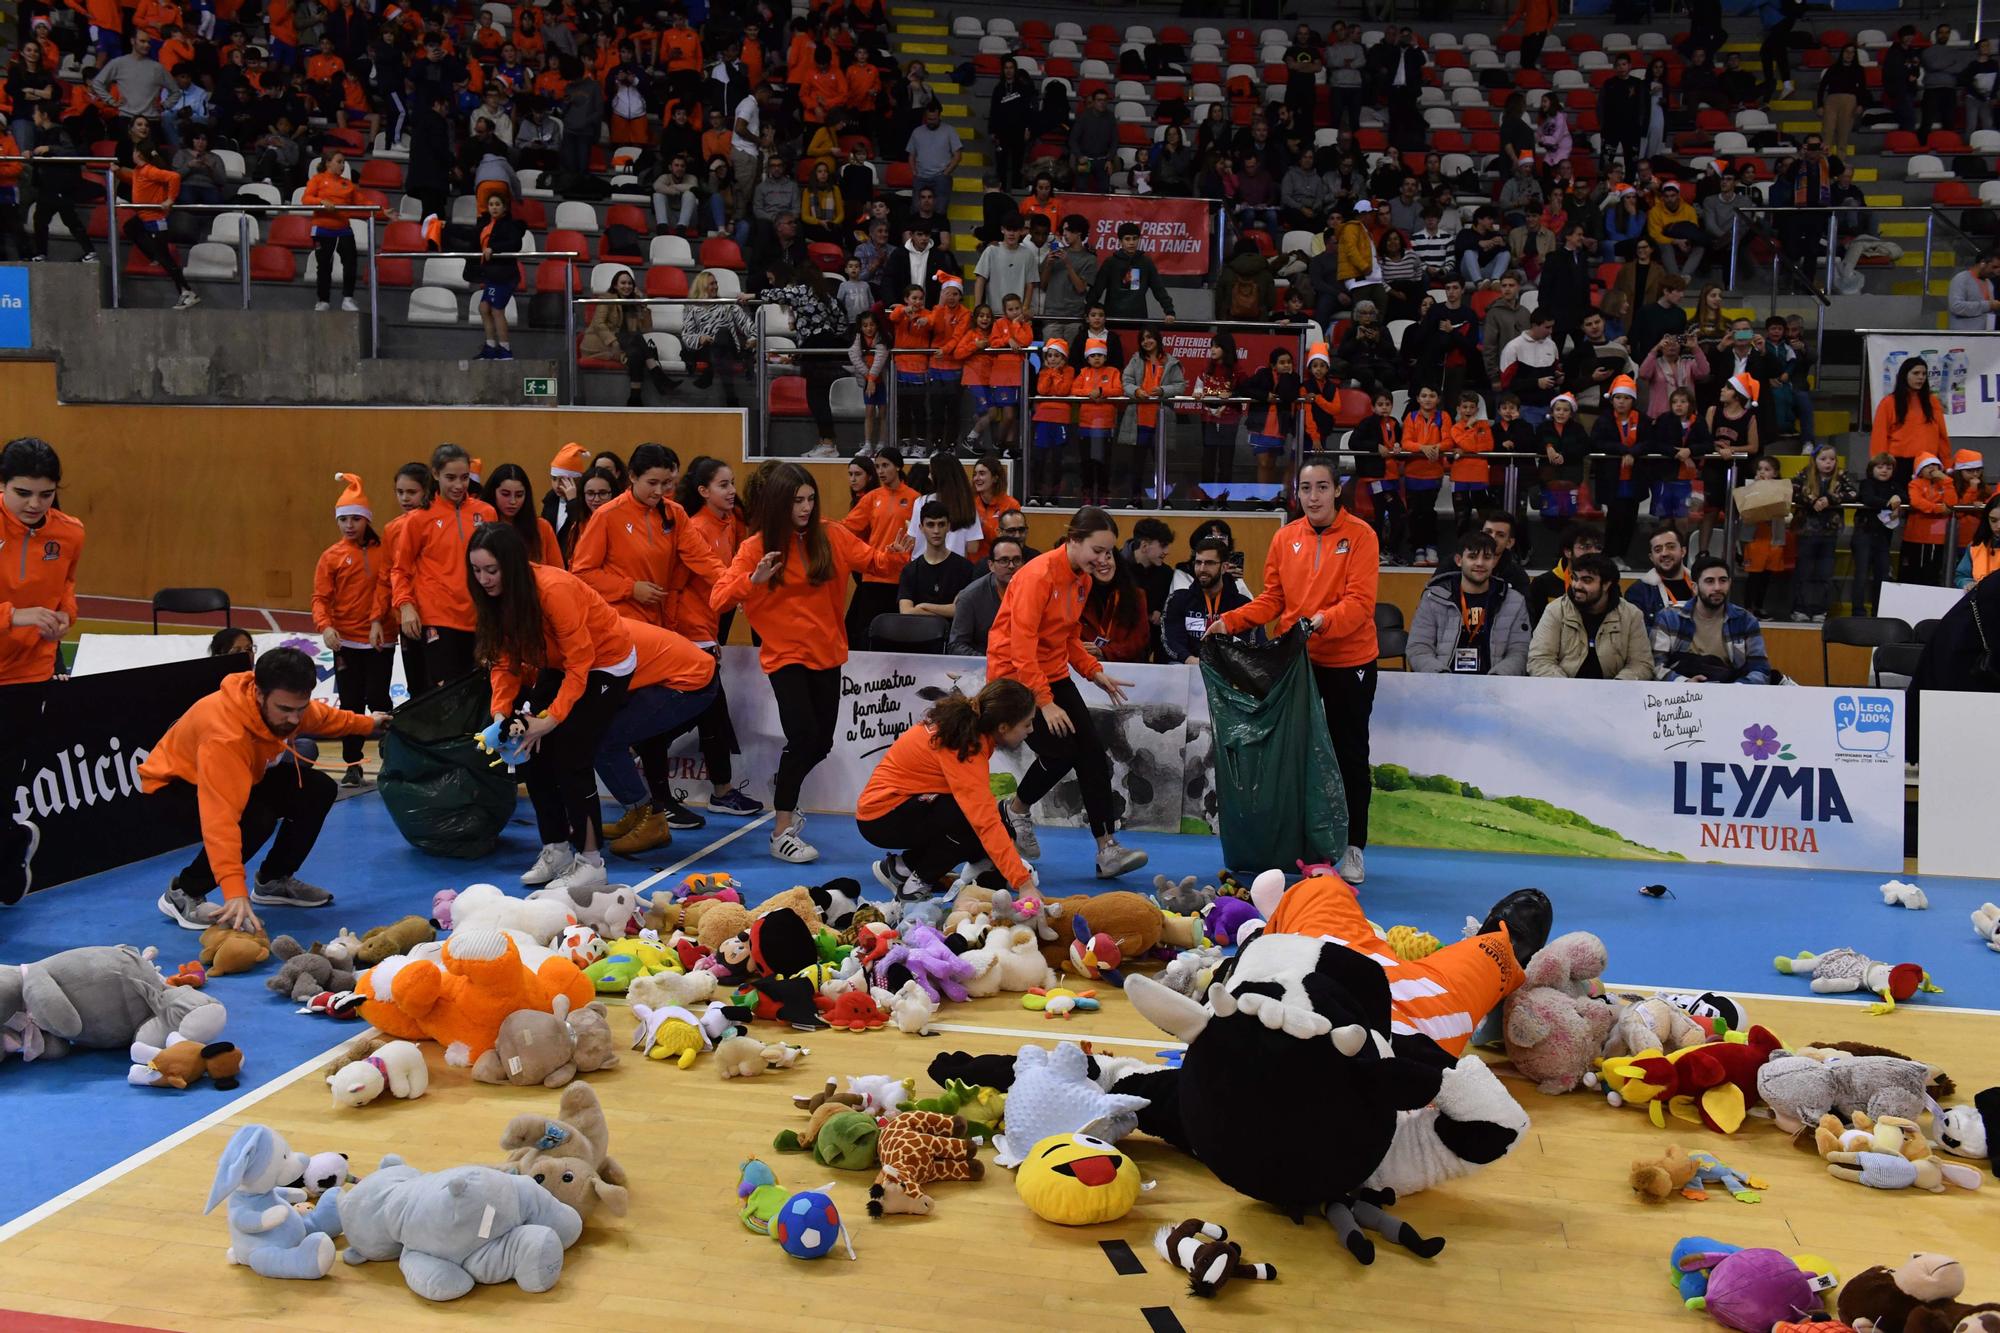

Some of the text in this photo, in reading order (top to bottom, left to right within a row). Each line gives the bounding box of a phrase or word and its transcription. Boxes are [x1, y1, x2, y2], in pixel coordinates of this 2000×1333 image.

[1096, 219, 1189, 238] SE PRESTA,
[1096, 234, 1104, 250] Á
[1159, 236, 1201, 253] TAMÉN
[1172, 347, 1205, 358] DEPORTE
[842, 669, 916, 696] De nuestra
[1664, 689, 1703, 706] nuestra
[853, 692, 901, 726] familia
[1656, 705, 1693, 728] familia
[1860, 713, 1890, 723] 100%
[847, 729, 858, 741] a
[860, 719, 876, 739] la
[1653, 719, 1703, 740] a la tuya!
[1674, 761, 1853, 823] LEYMA
[1700, 823, 1819, 853] NATURA
